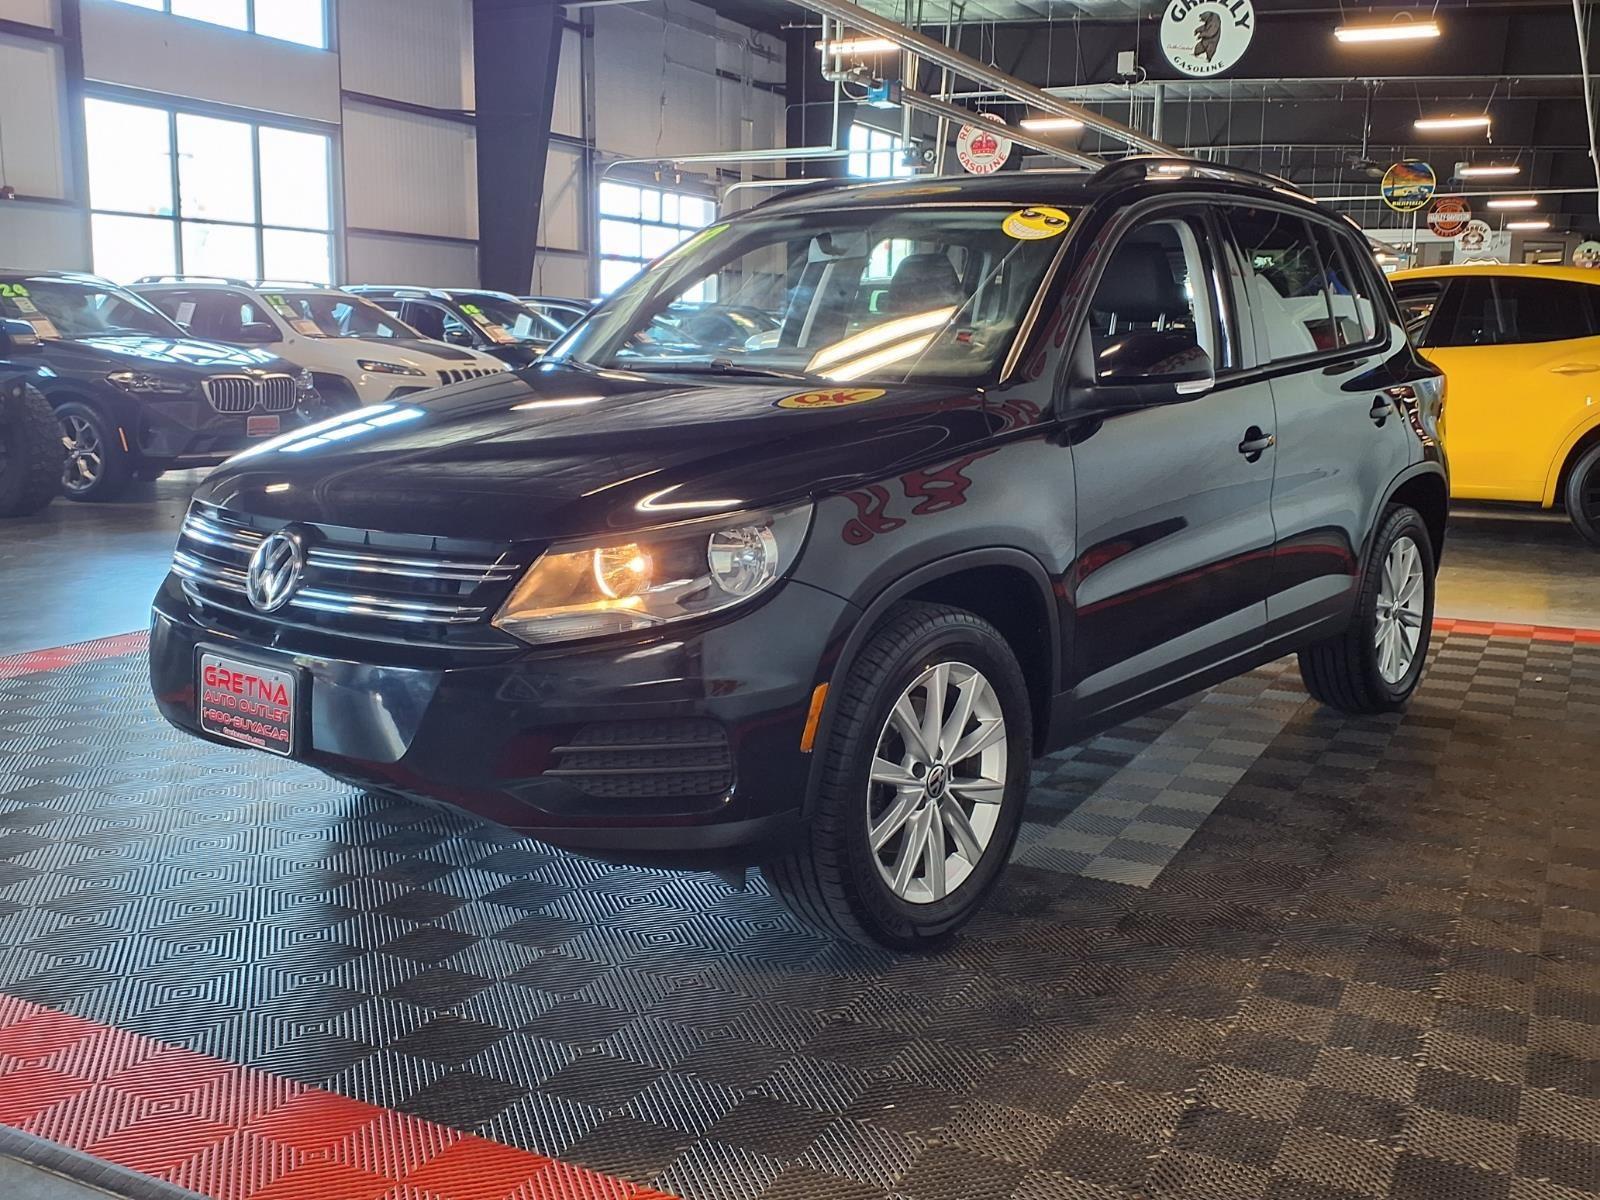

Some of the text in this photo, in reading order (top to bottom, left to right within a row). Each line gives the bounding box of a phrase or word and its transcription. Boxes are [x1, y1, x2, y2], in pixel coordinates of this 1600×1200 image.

[1173, 56, 1226, 73] GASOLINE
[959, 151, 1007, 174] GASOLINE
[204, 665, 290, 707] GRETNA
[203, 688, 291, 724] AUTO OUTLET
[203, 706, 290, 743] 1-800-BUYACAR
